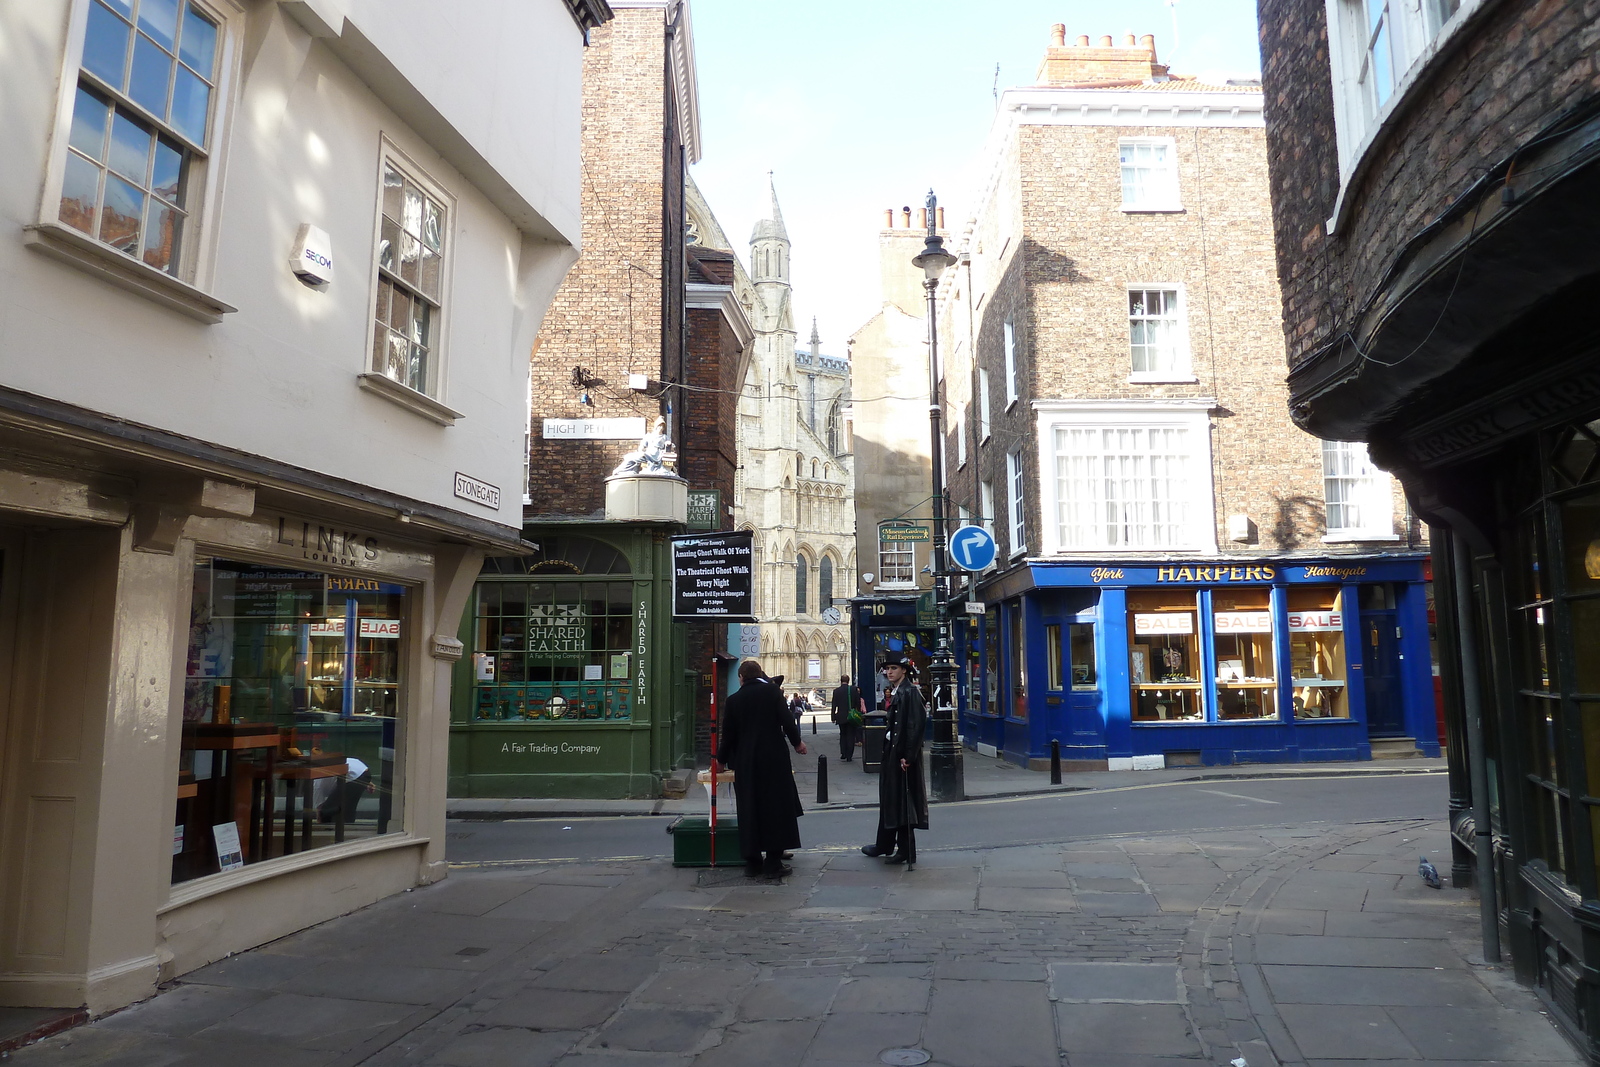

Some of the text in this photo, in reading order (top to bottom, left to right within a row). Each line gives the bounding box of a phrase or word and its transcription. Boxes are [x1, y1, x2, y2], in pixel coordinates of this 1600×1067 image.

[306, 248, 332, 270] SECOM
[546, 424, 576, 434] HIGH
[1413, 413, 1504, 461] HENRY
[456, 476, 499, 505] STONEGATE
[278, 516, 379, 561] LINKS
[303, 551, 356, 567] LONDON
[676, 550, 697, 558] Amazing
[687, 567, 715, 576] Theatrical
[716, 566, 732, 575] Ghost
[732, 566, 749, 574] Walk
[1090, 566, 1124, 583] York
[1157, 564, 1276, 583] HARPERS
[1304, 564, 1366, 580] Harrogate
[696, 578, 730, 588] Every Night
[872, 604, 886, 616] 10
[1136, 618, 1190, 630] SALE
[1216, 616, 1268, 628] SALE
[1288, 616, 1342, 627] SALE
[529, 628, 586, 639] SHARED
[638, 601, 646, 655] SHARED
[529, 640, 586, 651] EARTH
[638, 660, 646, 704] EARTH
[704, 676, 712, 685] H
[502, 742, 601, 755] A Fair Trading Company
